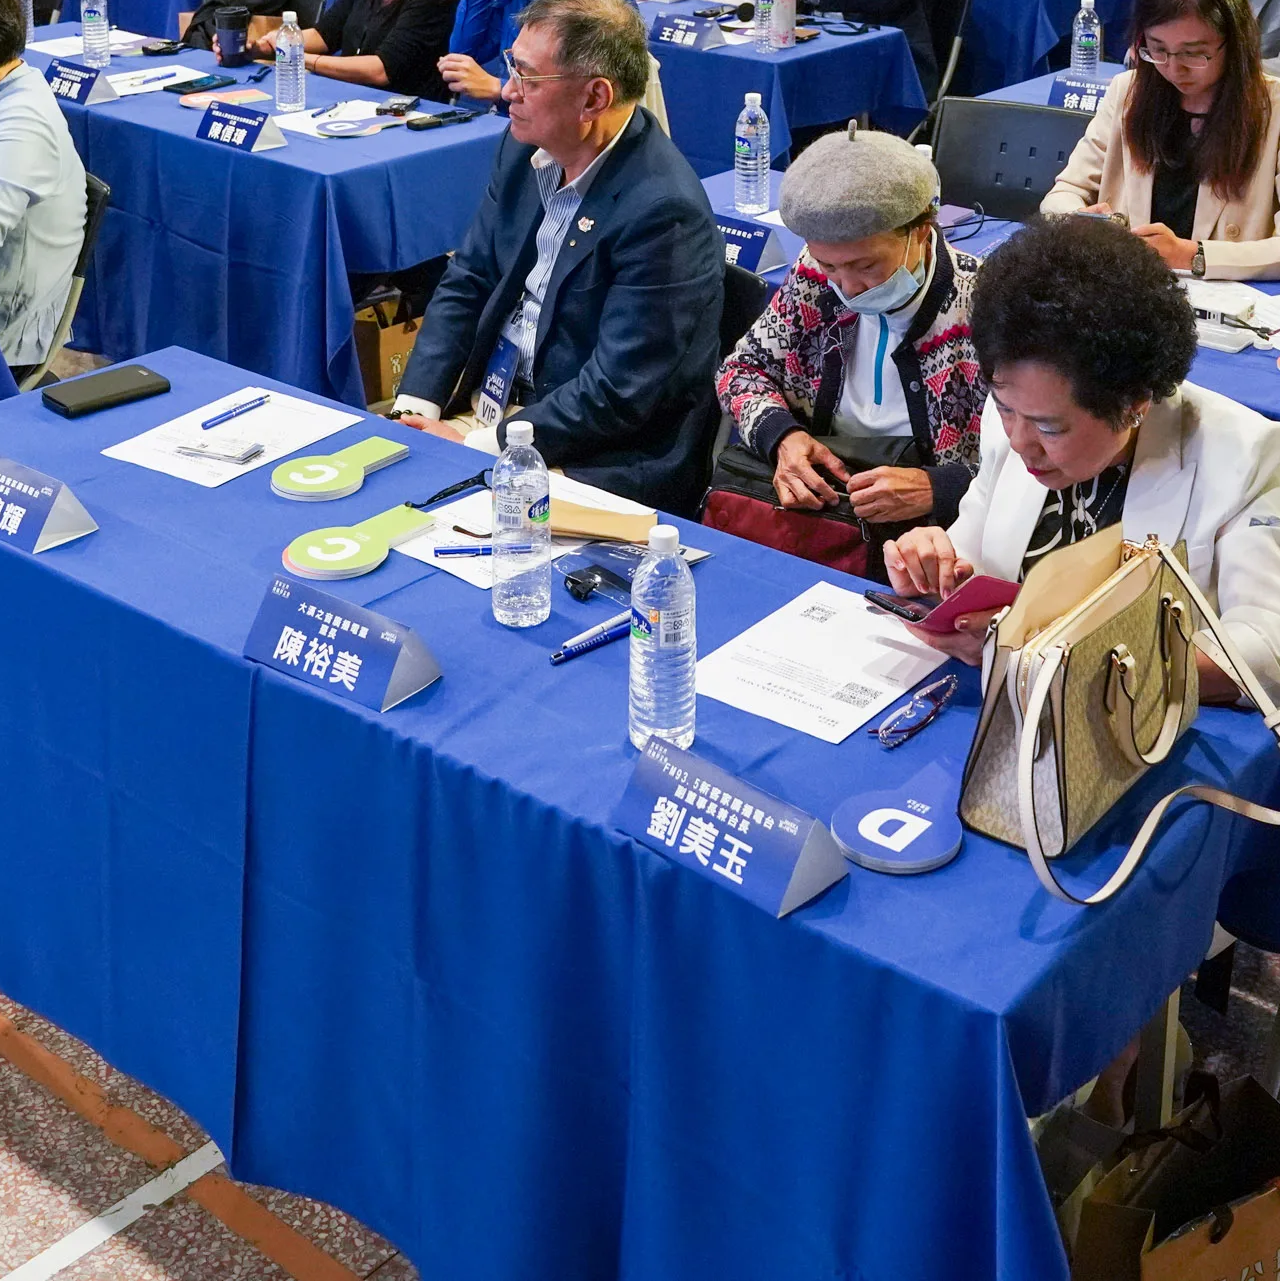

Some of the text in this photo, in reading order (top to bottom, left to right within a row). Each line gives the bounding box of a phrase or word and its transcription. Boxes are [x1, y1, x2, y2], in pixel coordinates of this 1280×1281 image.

[272, 625, 363, 692] 陳裕美
[646, 796, 753, 885] 劉美玉
[857, 807, 933, 853] D
